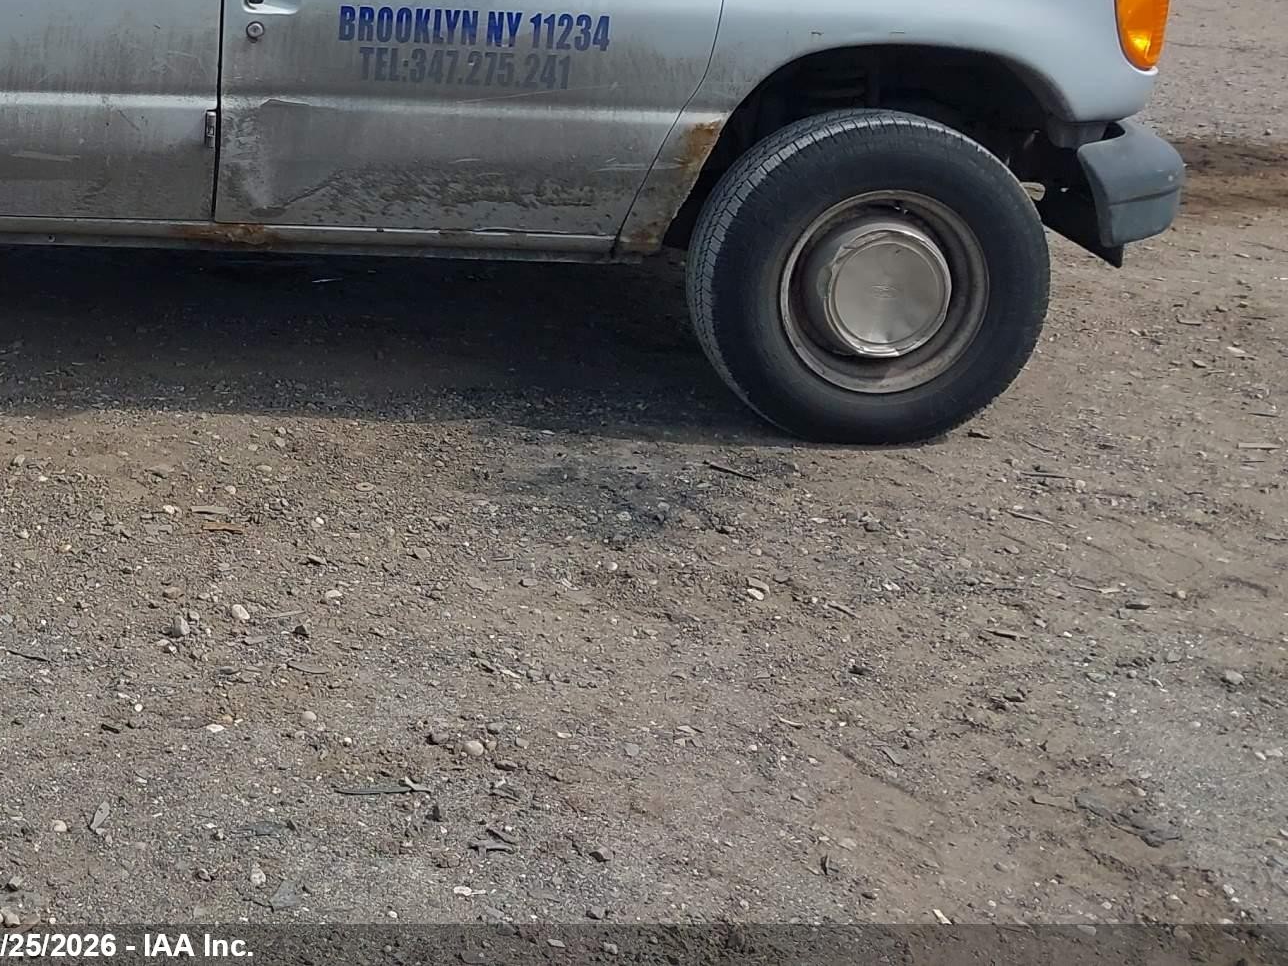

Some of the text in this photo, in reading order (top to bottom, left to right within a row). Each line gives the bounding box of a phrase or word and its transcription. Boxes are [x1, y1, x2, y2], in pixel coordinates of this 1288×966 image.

[339, 6, 611, 52] BROOKLYN NY 11234
